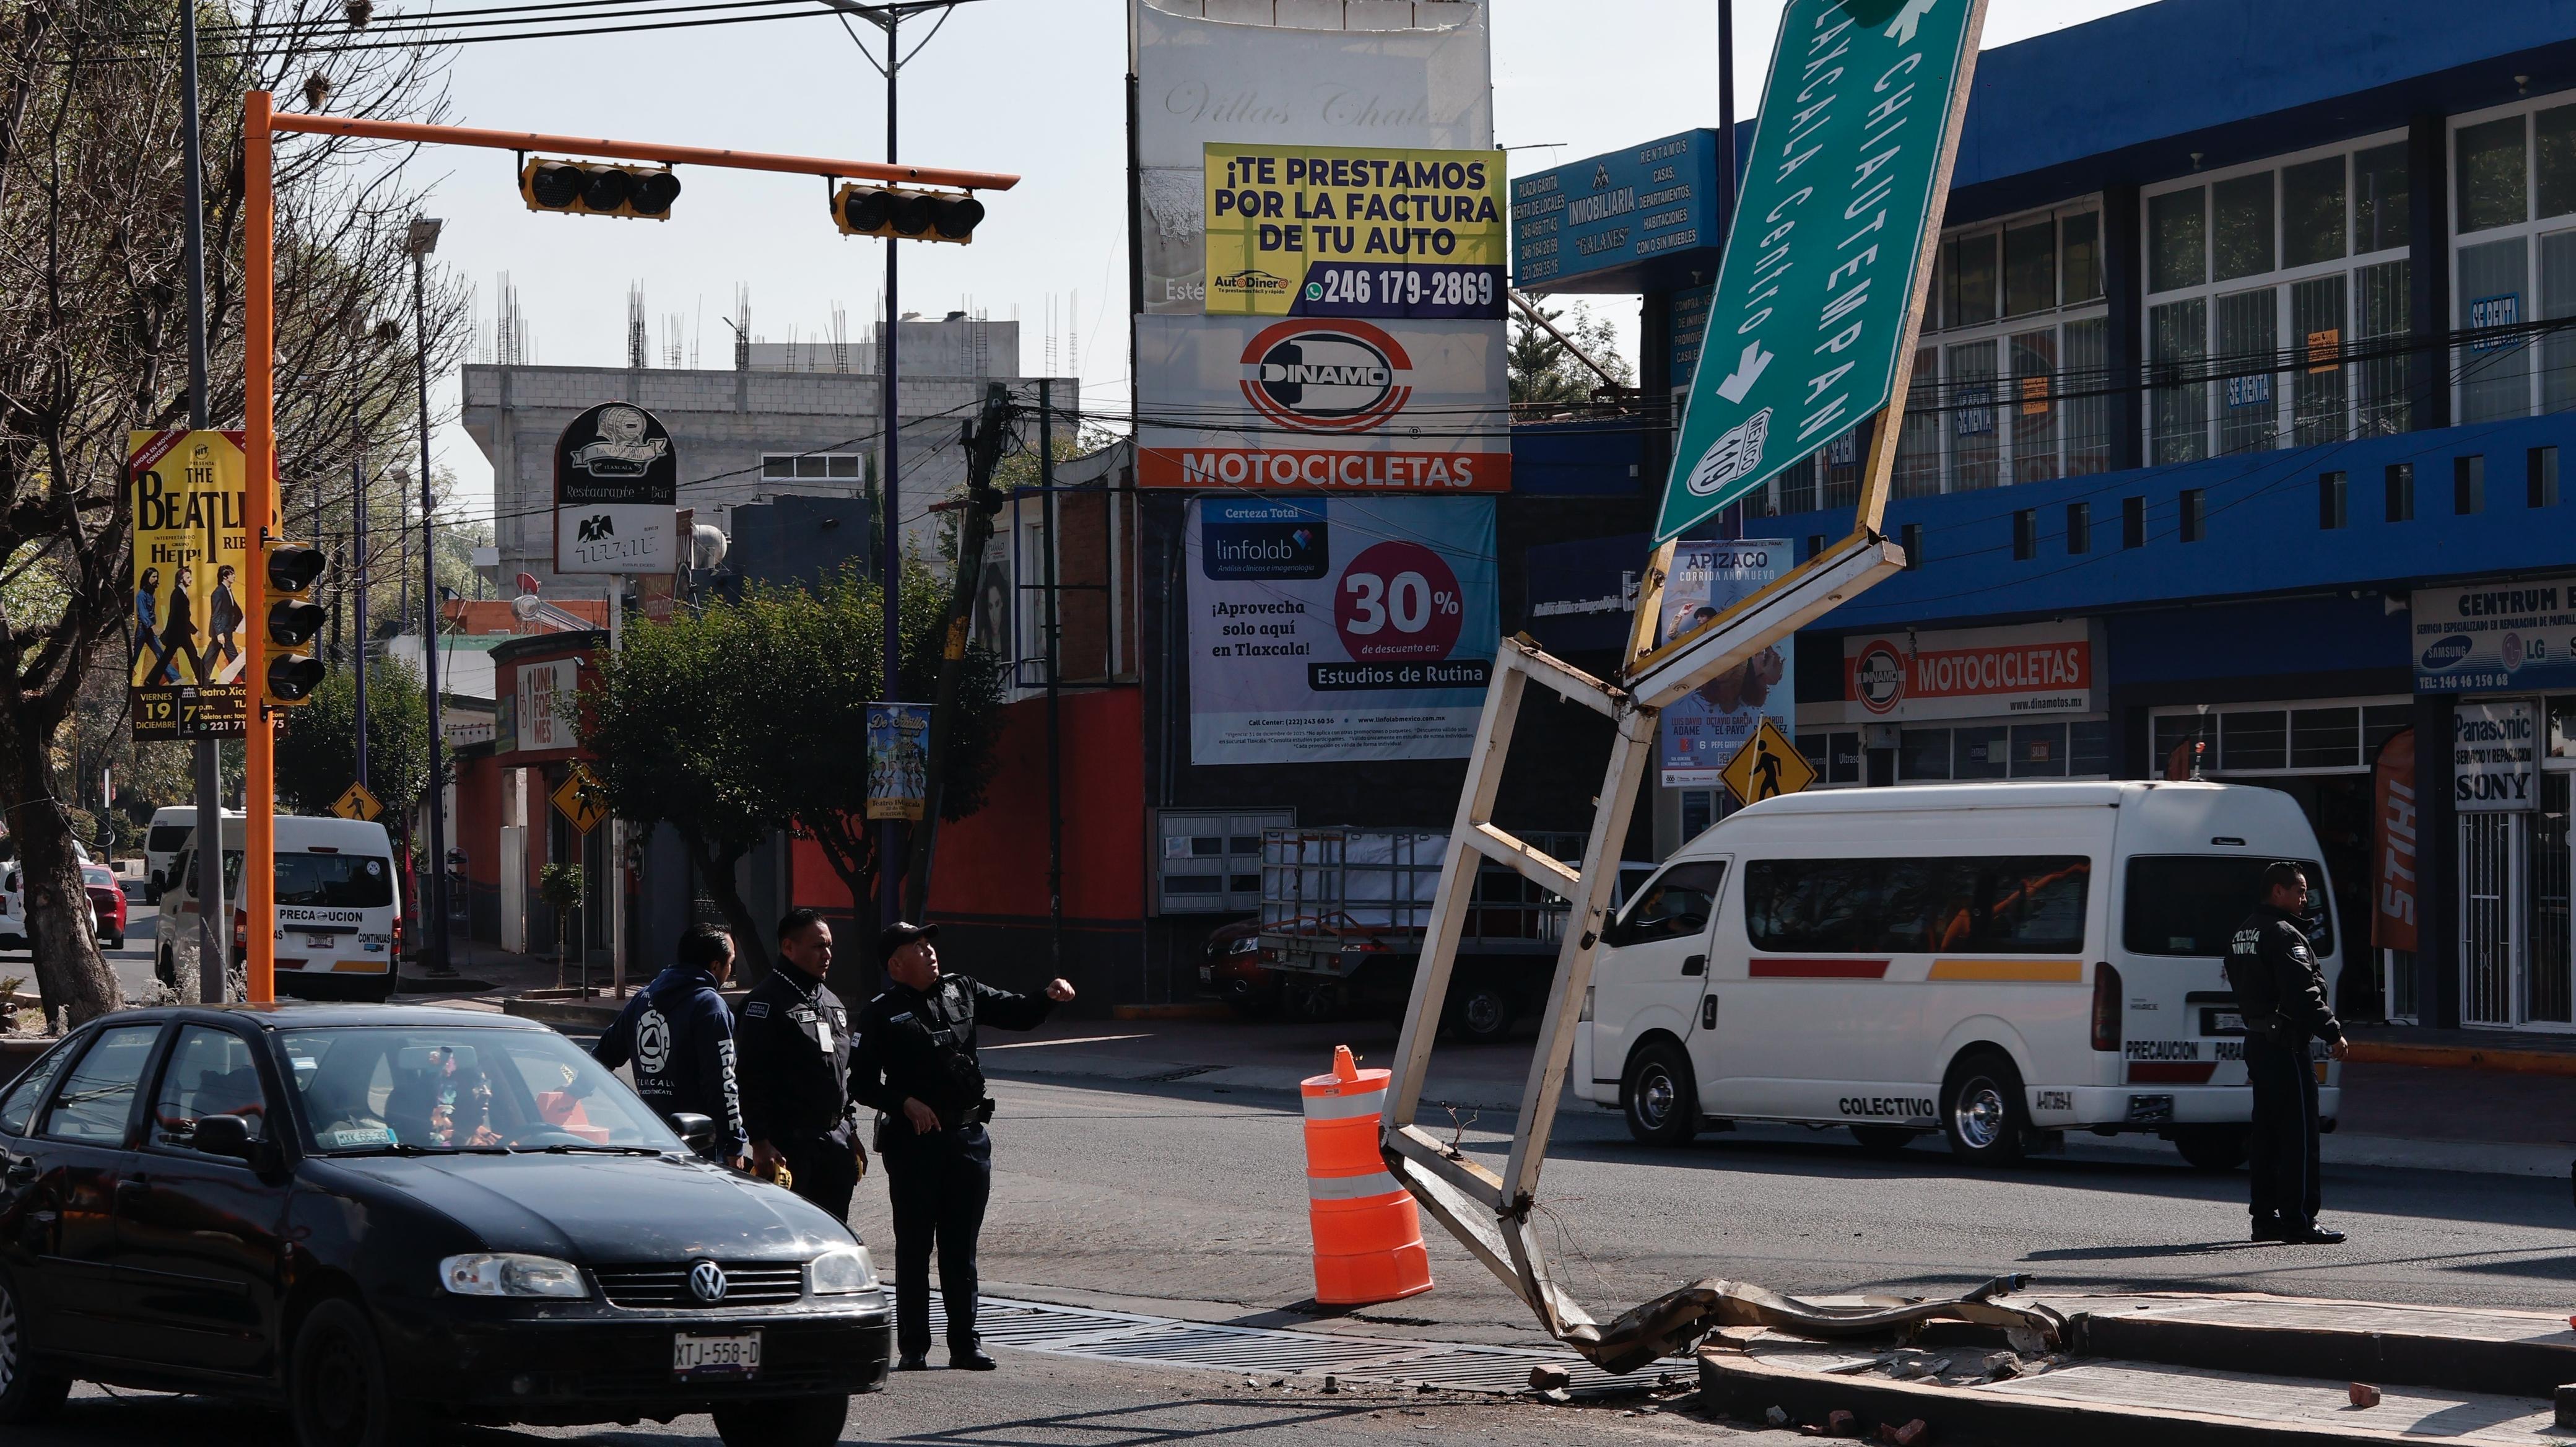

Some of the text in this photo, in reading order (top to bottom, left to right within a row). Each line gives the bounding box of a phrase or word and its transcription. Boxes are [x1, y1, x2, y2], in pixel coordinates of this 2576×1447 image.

[1165, 80, 1290, 125] Villas
[1640, 139, 1687, 164] RENTAMOS
[1227, 156, 1486, 190] ¡TE PRESTAMOS
[1738, 0, 1856, 336] LAXCALA Centro
[1518, 175, 1558, 198] PLAZA GARITA
[1215, 189, 1499, 223] POR LA FACTURA
[1513, 193, 1565, 221] RENTA DE LOCALES
[1568, 186, 1635, 227] INMOBILIARIA
[1643, 208, 1687, 230] HABITACIONES
[1259, 225, 1456, 256] DE TU AUTO
[1521, 224, 1531, 240] 246
[1637, 229, 1696, 256] CON O SIN MUEBLES
[1796, 52, 1922, 444] CHIAUTEMPAN
[1521, 245, 1531, 261] 246
[1324, 269, 1492, 304] 246 179-2869
[1674, 297, 1700, 312] COMPRA
[1677, 318, 1686, 329] DE
[1676, 351, 1694, 364] CASA
[1262, 363, 1390, 387] DINAMO
[2229, 373, 2269, 407] SE RENTA
[133, 431, 175, 468] AHORA EN MOVIES
[1741, 415, 1765, 471] MEXICO
[1840, 427, 1857, 465] RENT
[146, 444, 169, 465] CONCERT!
[1700, 439, 1741, 486] 119
[185, 468, 214, 483] THE
[1183, 453, 1473, 487] MOTOCICLETAS
[567, 485, 670, 499] Restaurante Bar
[1225, 508, 1299, 518] Certeza Total
[150, 543, 201, 569] HELP!
[1217, 539, 1292, 560] linfolab
[1217, 564, 1242, 573] Análisis
[1242, 564, 1266, 572] clínicos
[1271, 564, 1315, 573] imagenología
[1686, 551, 1768, 569] APIZACO
[1679, 570, 1721, 582] CORRIDA
[1744, 569, 1775, 580] NUEVO
[1212, 600, 1305, 618] ¡Aprovecha
[2458, 588, 2557, 616] CENTRUM
[1222, 619, 1295, 638] solo aquí
[2417, 613, 2576, 635] SERVICIO ESPECIALIZADO EN REPARACION DE PANTALL
[1212, 642, 1310, 657] en Tlaxcala!
[1362, 642, 1440, 654] de descuento en:
[2427, 639, 2546, 659] SAMSUNG LG
[1318, 665, 1484, 684] Estudios de Rutina
[1861, 670, 1900, 684] DINAMO
[1918, 647, 2078, 692] MOTOCICLETAS
[534, 667, 550, 693] UNI
[2419, 676, 2437, 689] TEL:
[2439, 675, 2457, 689] 246
[2460, 675, 2472, 688] 46
[2496, 673, 2509, 686] 68
[140, 693, 173, 701] VIERNES
[198, 687, 226, 696] Teatro
[146, 702, 171, 719] 19
[183, 704, 215, 722] 7 p.m.
[534, 693, 551, 719] FOR
[2010, 697, 2082, 711] www.dinamotos.mx
[136, 720, 176, 729] DICIEMBRE
[210, 721, 228, 731] 221
[1286, 719, 1302, 727] (222)
[1671, 717, 1684, 726] LUIS
[1685, 717, 1702, 726] DAVID
[1706, 716, 1731, 726] OCTAVIO
[1673, 726, 1701, 736] ADAME
[1726, 725, 1749, 735] PAYO"
[2455, 713, 2531, 743] Panasonic
[534, 719, 551, 744] MES
[2456, 747, 2531, 765] SERVICIO Y REPARACION
[2456, 772, 2531, 802] SONY
[358, 933, 391, 944] CONTINUAS
[2126, 1041, 2198, 1060] PRECAUCION
[717, 1038, 743, 1131] RESCATE
[1839, 1098, 1934, 1116] COLECTIVO
[675, 1341, 759, 1366] XTJ-558-D
